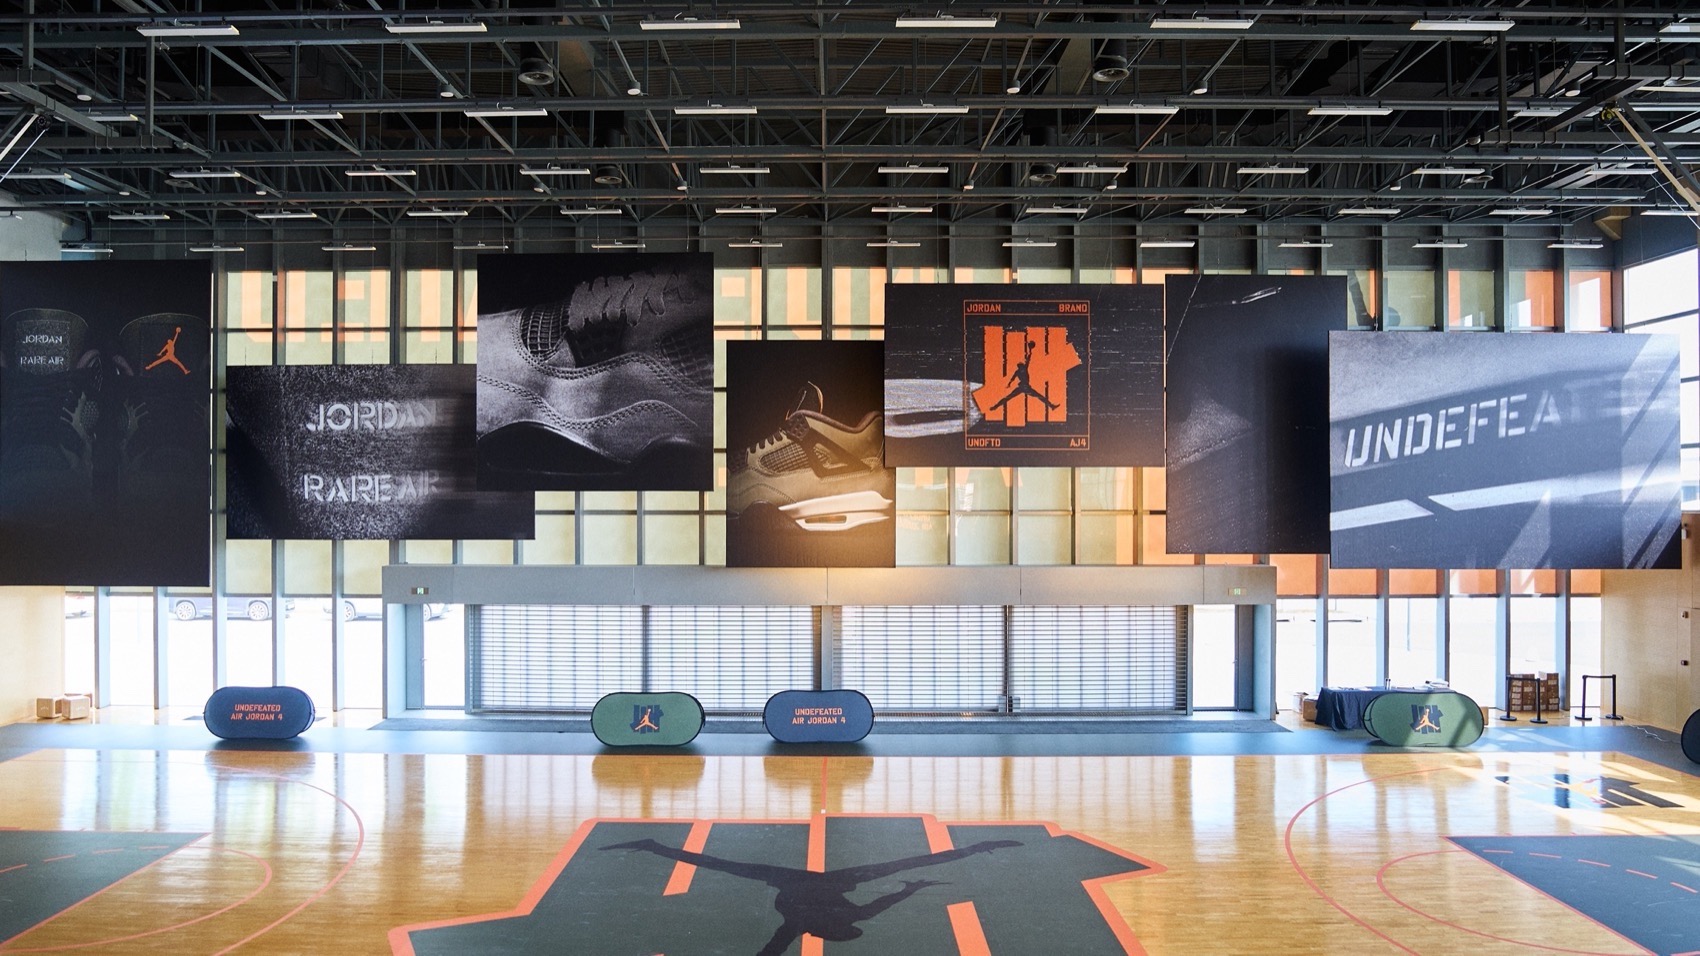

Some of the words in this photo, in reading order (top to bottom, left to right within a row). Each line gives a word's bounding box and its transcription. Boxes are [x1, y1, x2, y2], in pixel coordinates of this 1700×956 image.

[967, 303, 1002, 313] JORDAN
[1059, 303, 1088, 313] BRAND
[22, 334, 63, 344] JORDAN
[20, 355, 47, 365] RARE
[48, 356, 64, 365] AIR
[306, 400, 437, 431] JORDAN
[967, 438, 1001, 447] UNDFTD
[1070, 438, 1087, 447] AJ4
[304, 473, 392, 502] RARE
[396, 469, 440, 500] AIR
[234, 703, 281, 712] UNDEFEATED
[794, 707, 842, 716] UNDEFEATED
